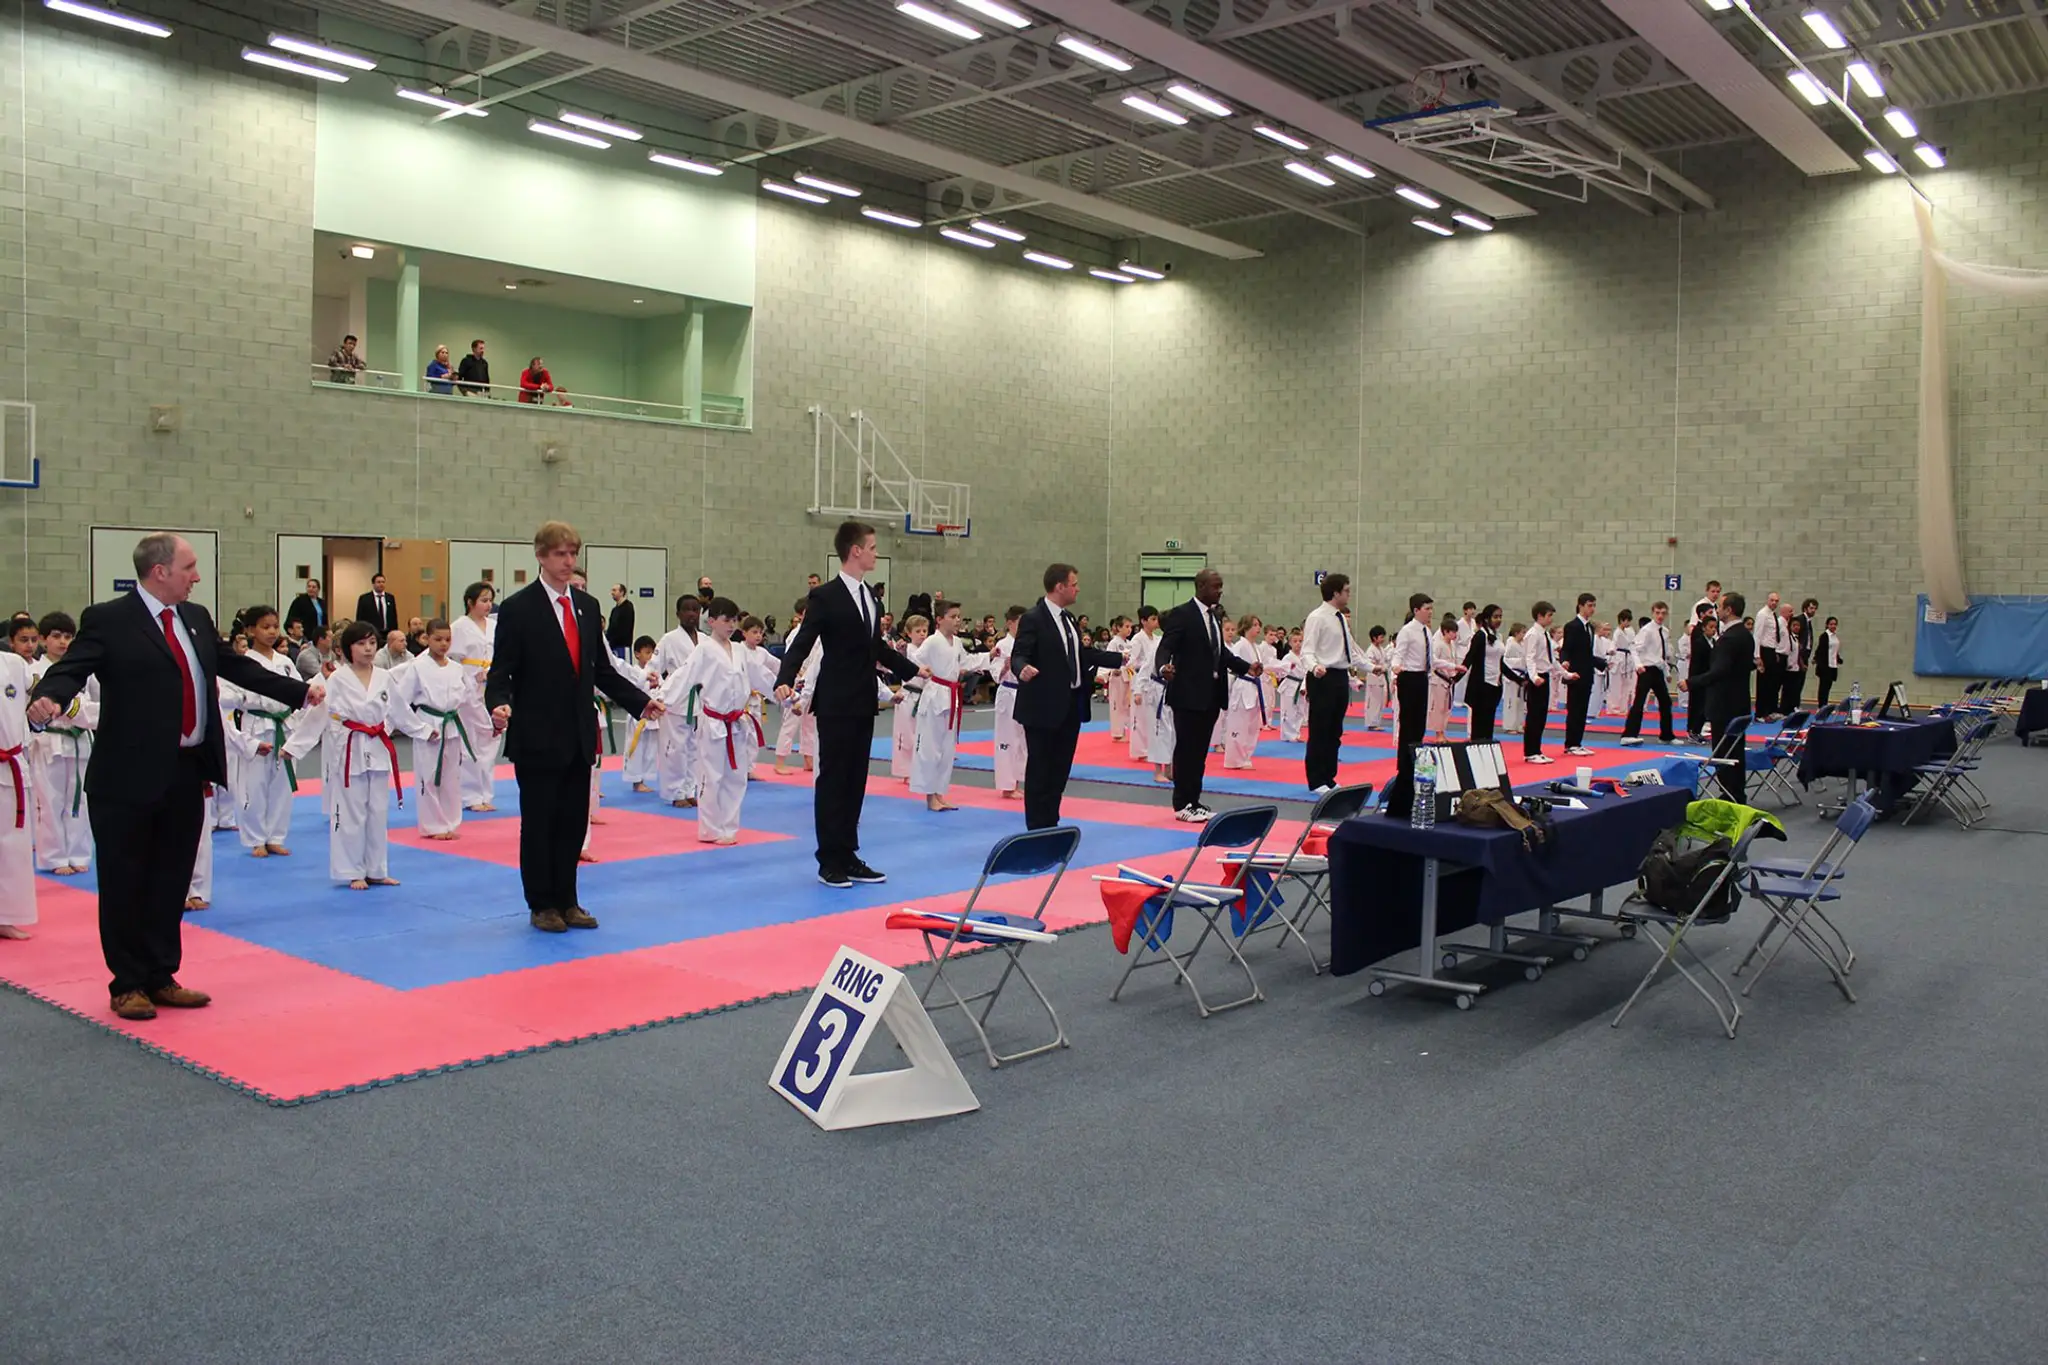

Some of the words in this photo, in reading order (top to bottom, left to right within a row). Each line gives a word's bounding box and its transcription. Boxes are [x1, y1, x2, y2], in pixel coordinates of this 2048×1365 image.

[1669, 578, 1678, 590] 5
[831, 957, 884, 1004] RING
[794, 1008, 848, 1094] 3
